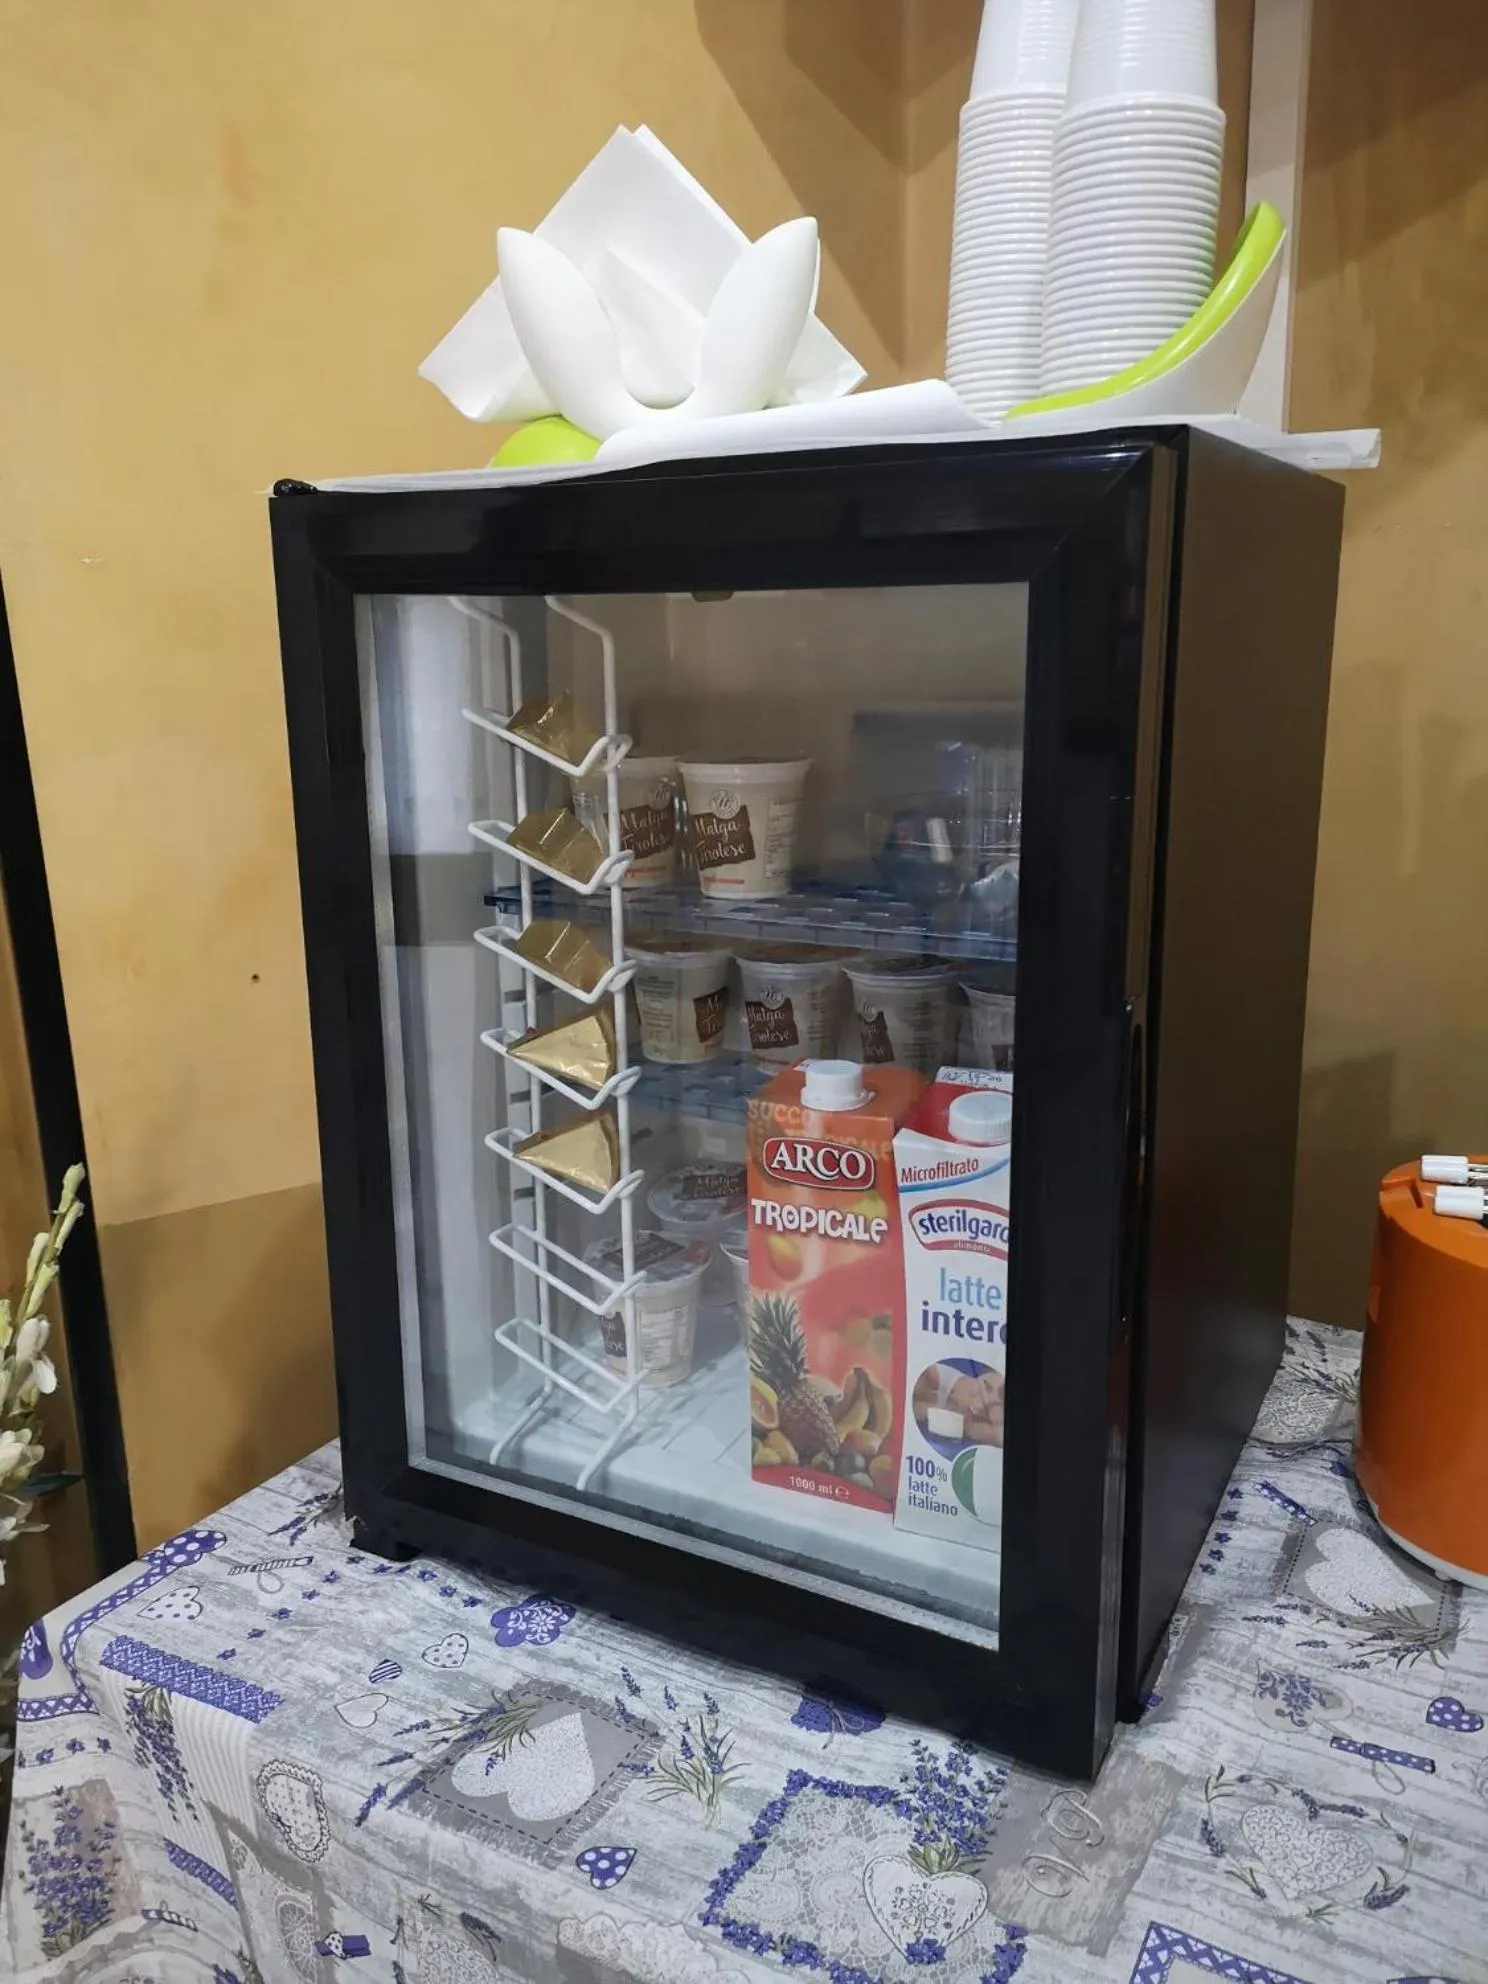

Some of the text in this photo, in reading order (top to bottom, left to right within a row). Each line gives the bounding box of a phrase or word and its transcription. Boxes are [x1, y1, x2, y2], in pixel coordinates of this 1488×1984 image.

[694, 817, 739, 842] Malga
[770, 1141, 867, 1180] ARCO
[901, 1157, 979, 1184] Microfiltrato
[940, 1268, 1001, 1310] latte
[905, 1455, 948, 1482] 100%
[789, 1475, 816, 1491] 1000
[908, 1475, 938, 1496] latte
[908, 1491, 958, 1516] italiano
